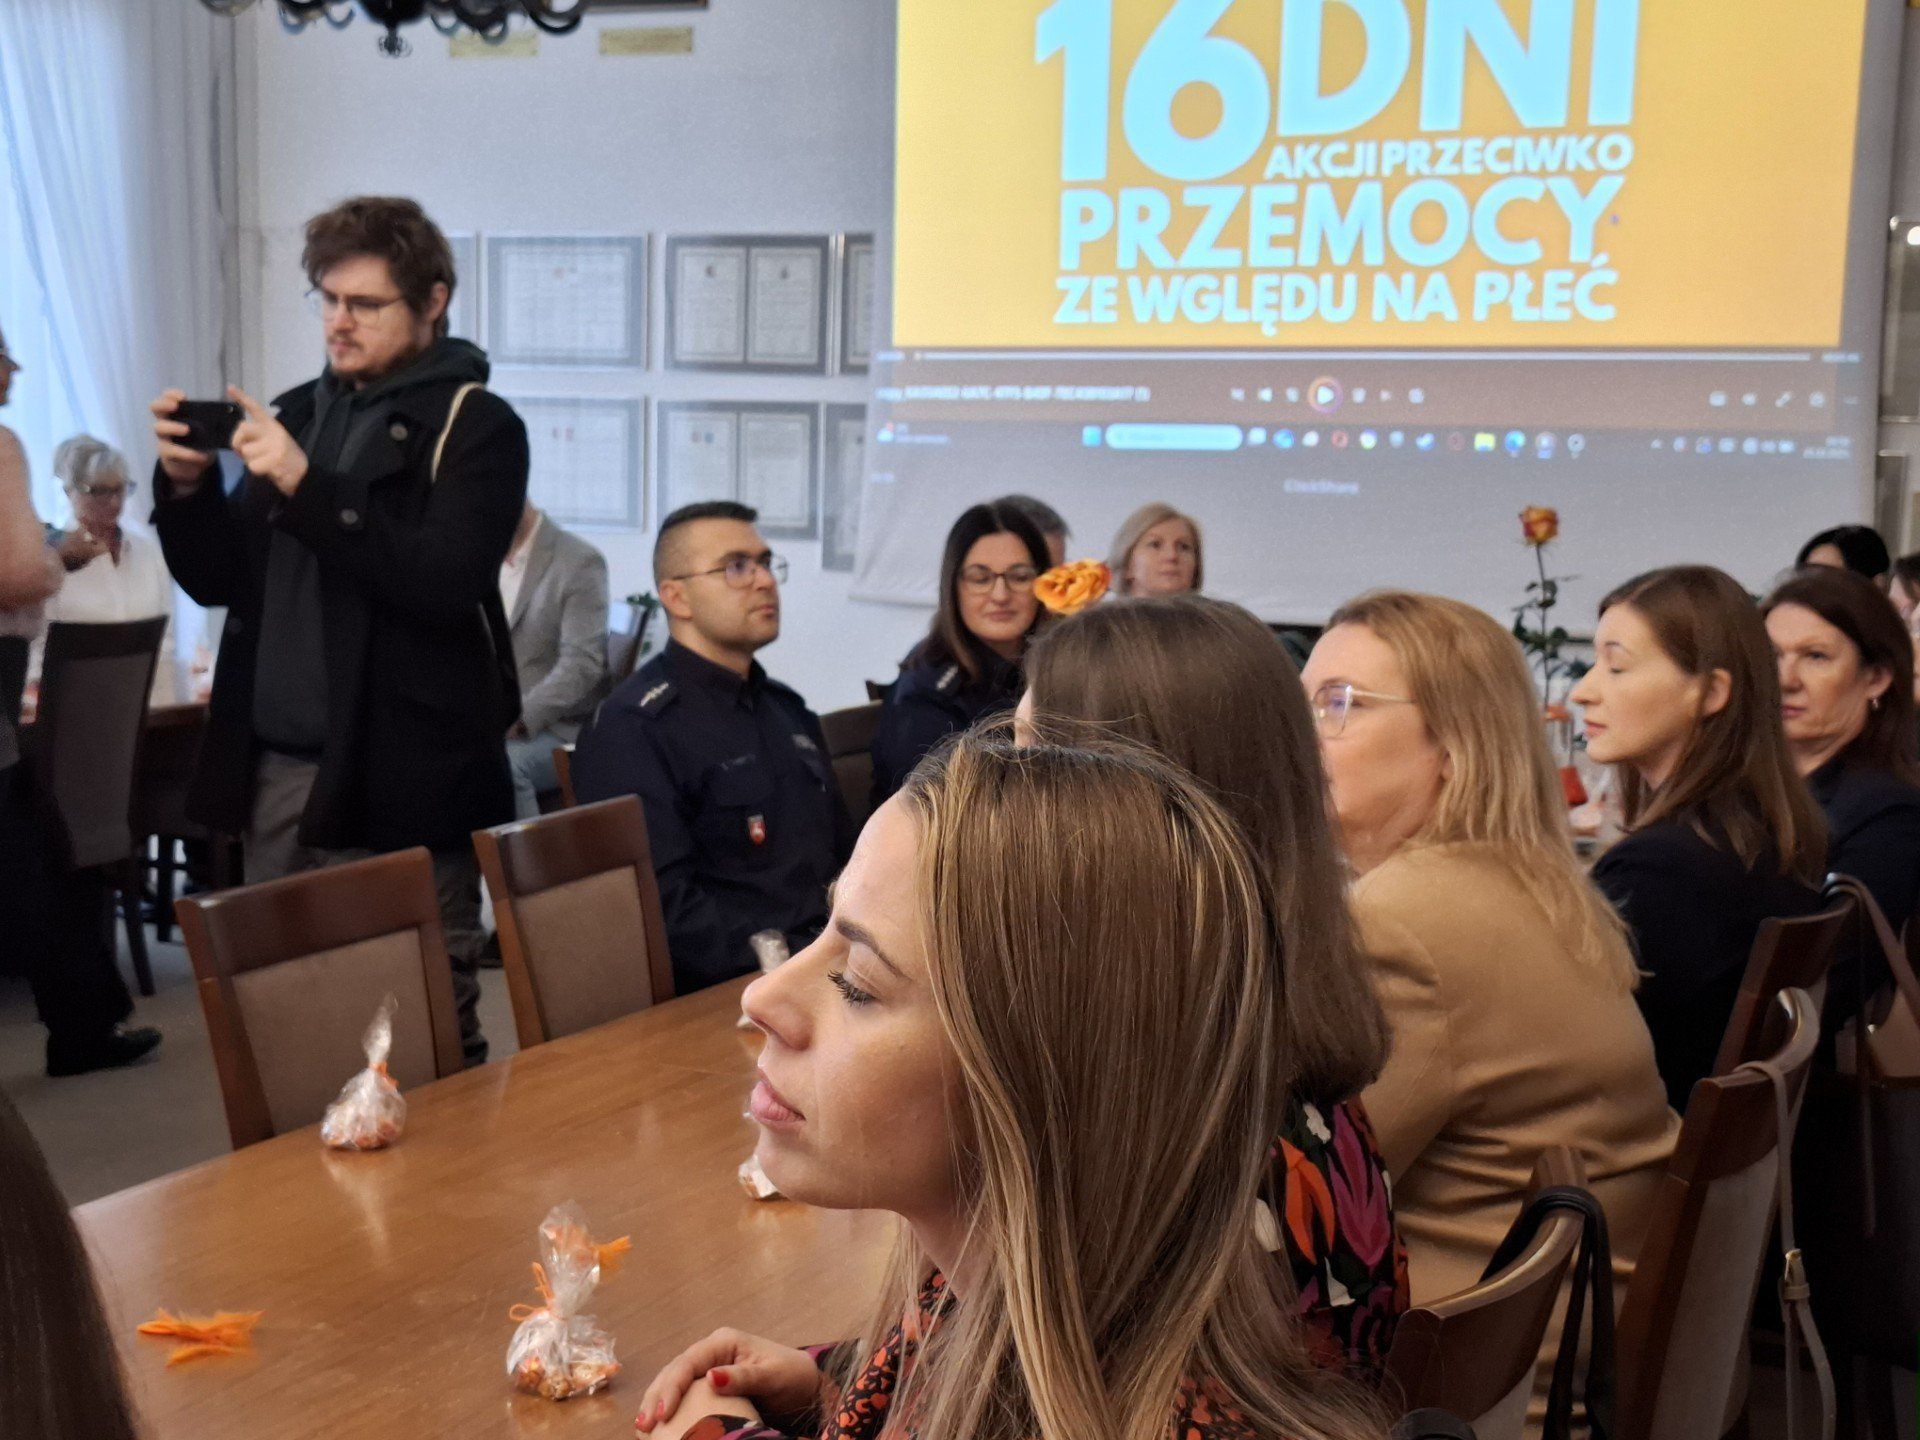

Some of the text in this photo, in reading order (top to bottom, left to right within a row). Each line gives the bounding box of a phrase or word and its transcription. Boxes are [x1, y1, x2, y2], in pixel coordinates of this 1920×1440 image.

[1035, 0, 1640, 183] 16 DNI
[1264, 133, 1635, 181] AKCJI PRZECIWKO
[1058, 175, 1626, 272] PRZEMOCY
[1053, 253, 1619, 337] ZE WGLĘDU NA PŁEĆ
